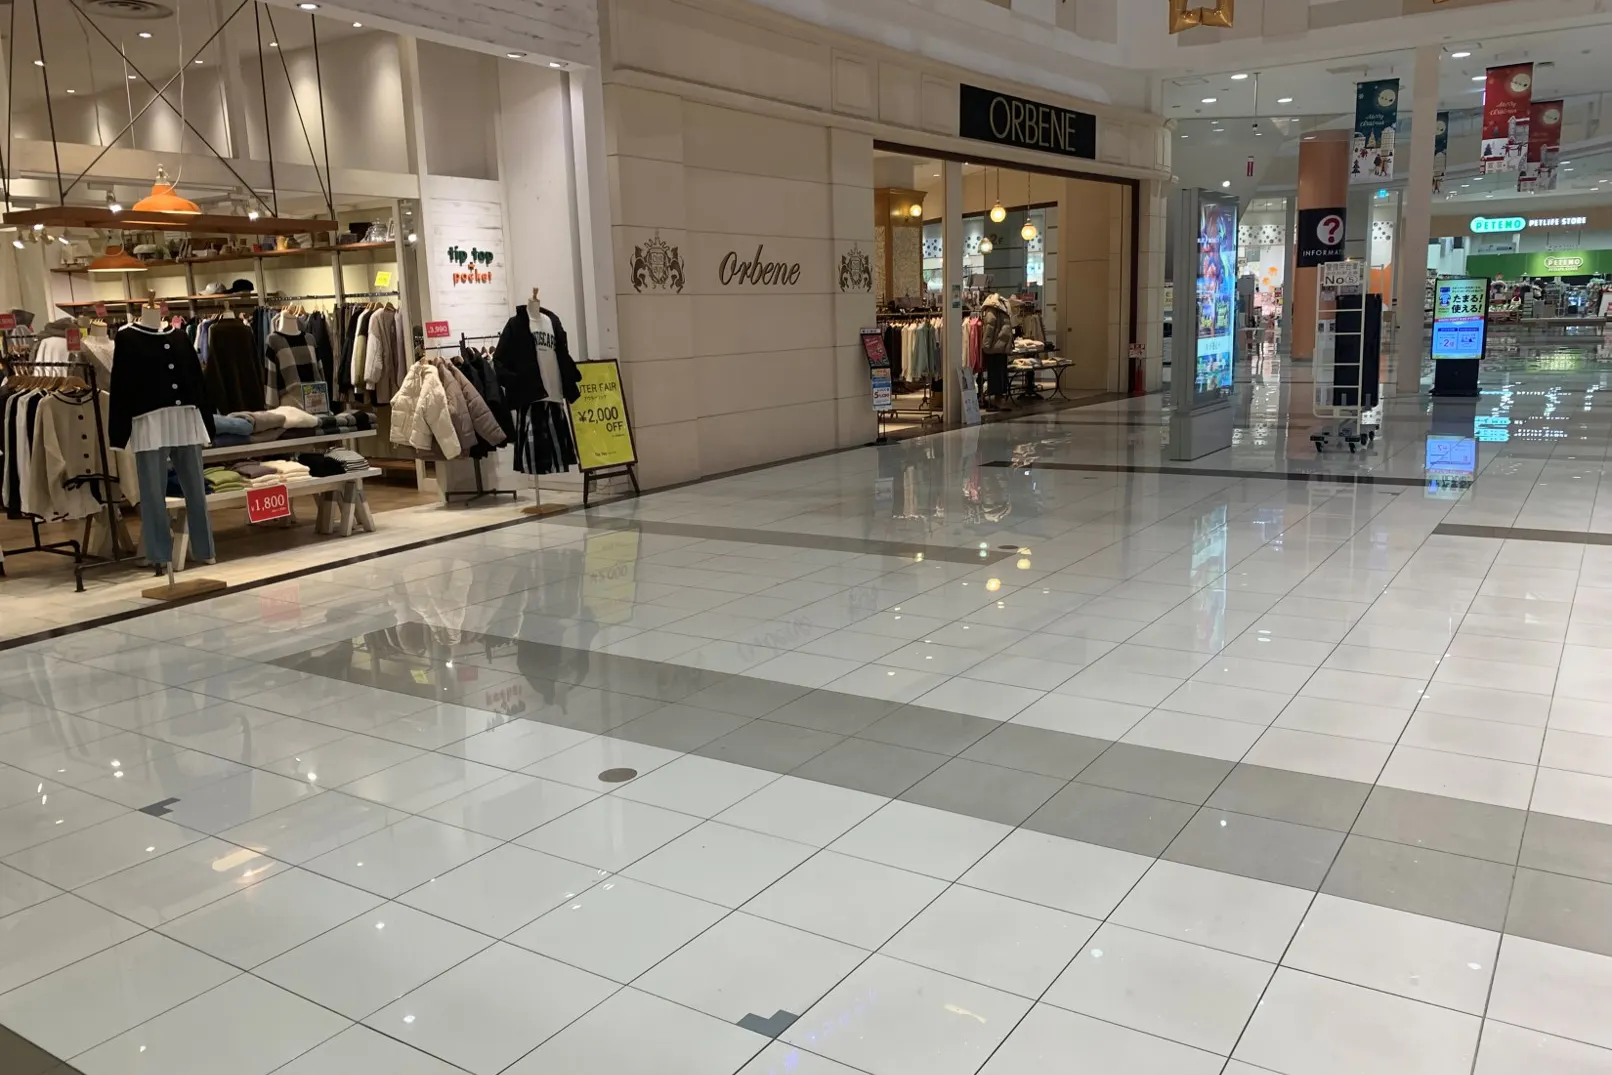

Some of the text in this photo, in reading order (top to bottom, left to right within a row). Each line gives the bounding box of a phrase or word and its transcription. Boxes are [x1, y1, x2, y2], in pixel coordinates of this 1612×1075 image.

[990, 96, 1076, 152] ORBENE
[1474, 216, 1587, 231] PETEMO PETLIFE STORE
[447, 245, 494, 267] tip top
[718, 243, 801, 286] Orbene
[1547, 257, 1581, 266] PETEMO
[452, 268, 493, 288] pocket
[599, 381, 617, 392] FAIR
[578, 406, 619, 424] ¥2,000
[605, 420, 625, 433] OFF
